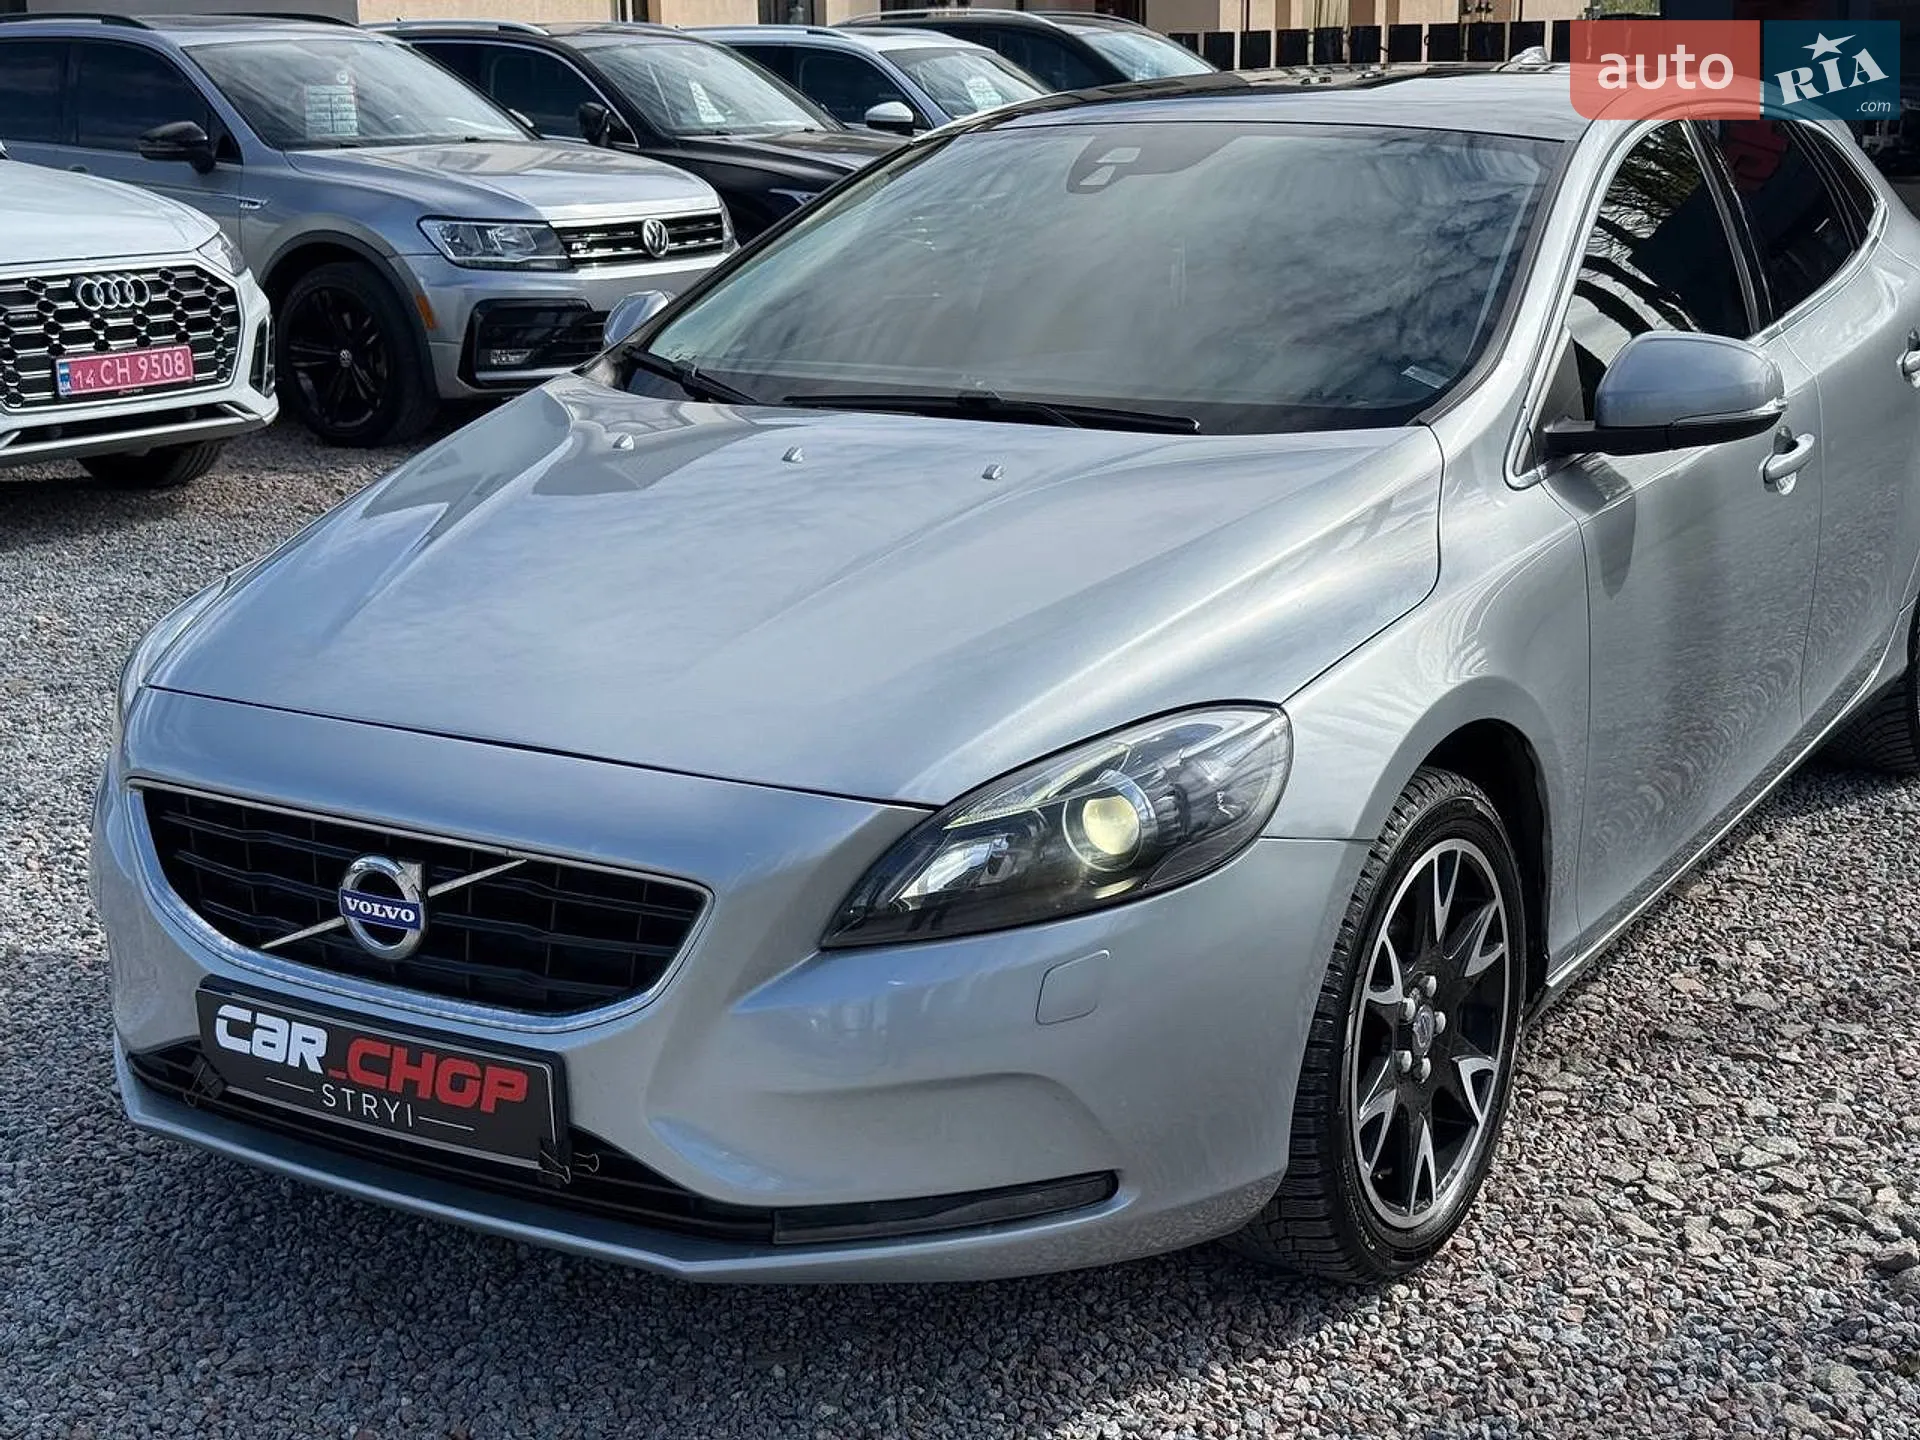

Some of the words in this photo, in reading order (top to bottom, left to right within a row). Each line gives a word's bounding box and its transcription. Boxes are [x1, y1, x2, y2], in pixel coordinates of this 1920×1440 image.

[75, 369, 95, 389] 14
[100, 359, 131, 385] CH
[137, 351, 186, 381] 9508
[343, 896, 416, 922] VOLVO
[322, 1083, 413, 1127] STRYI
